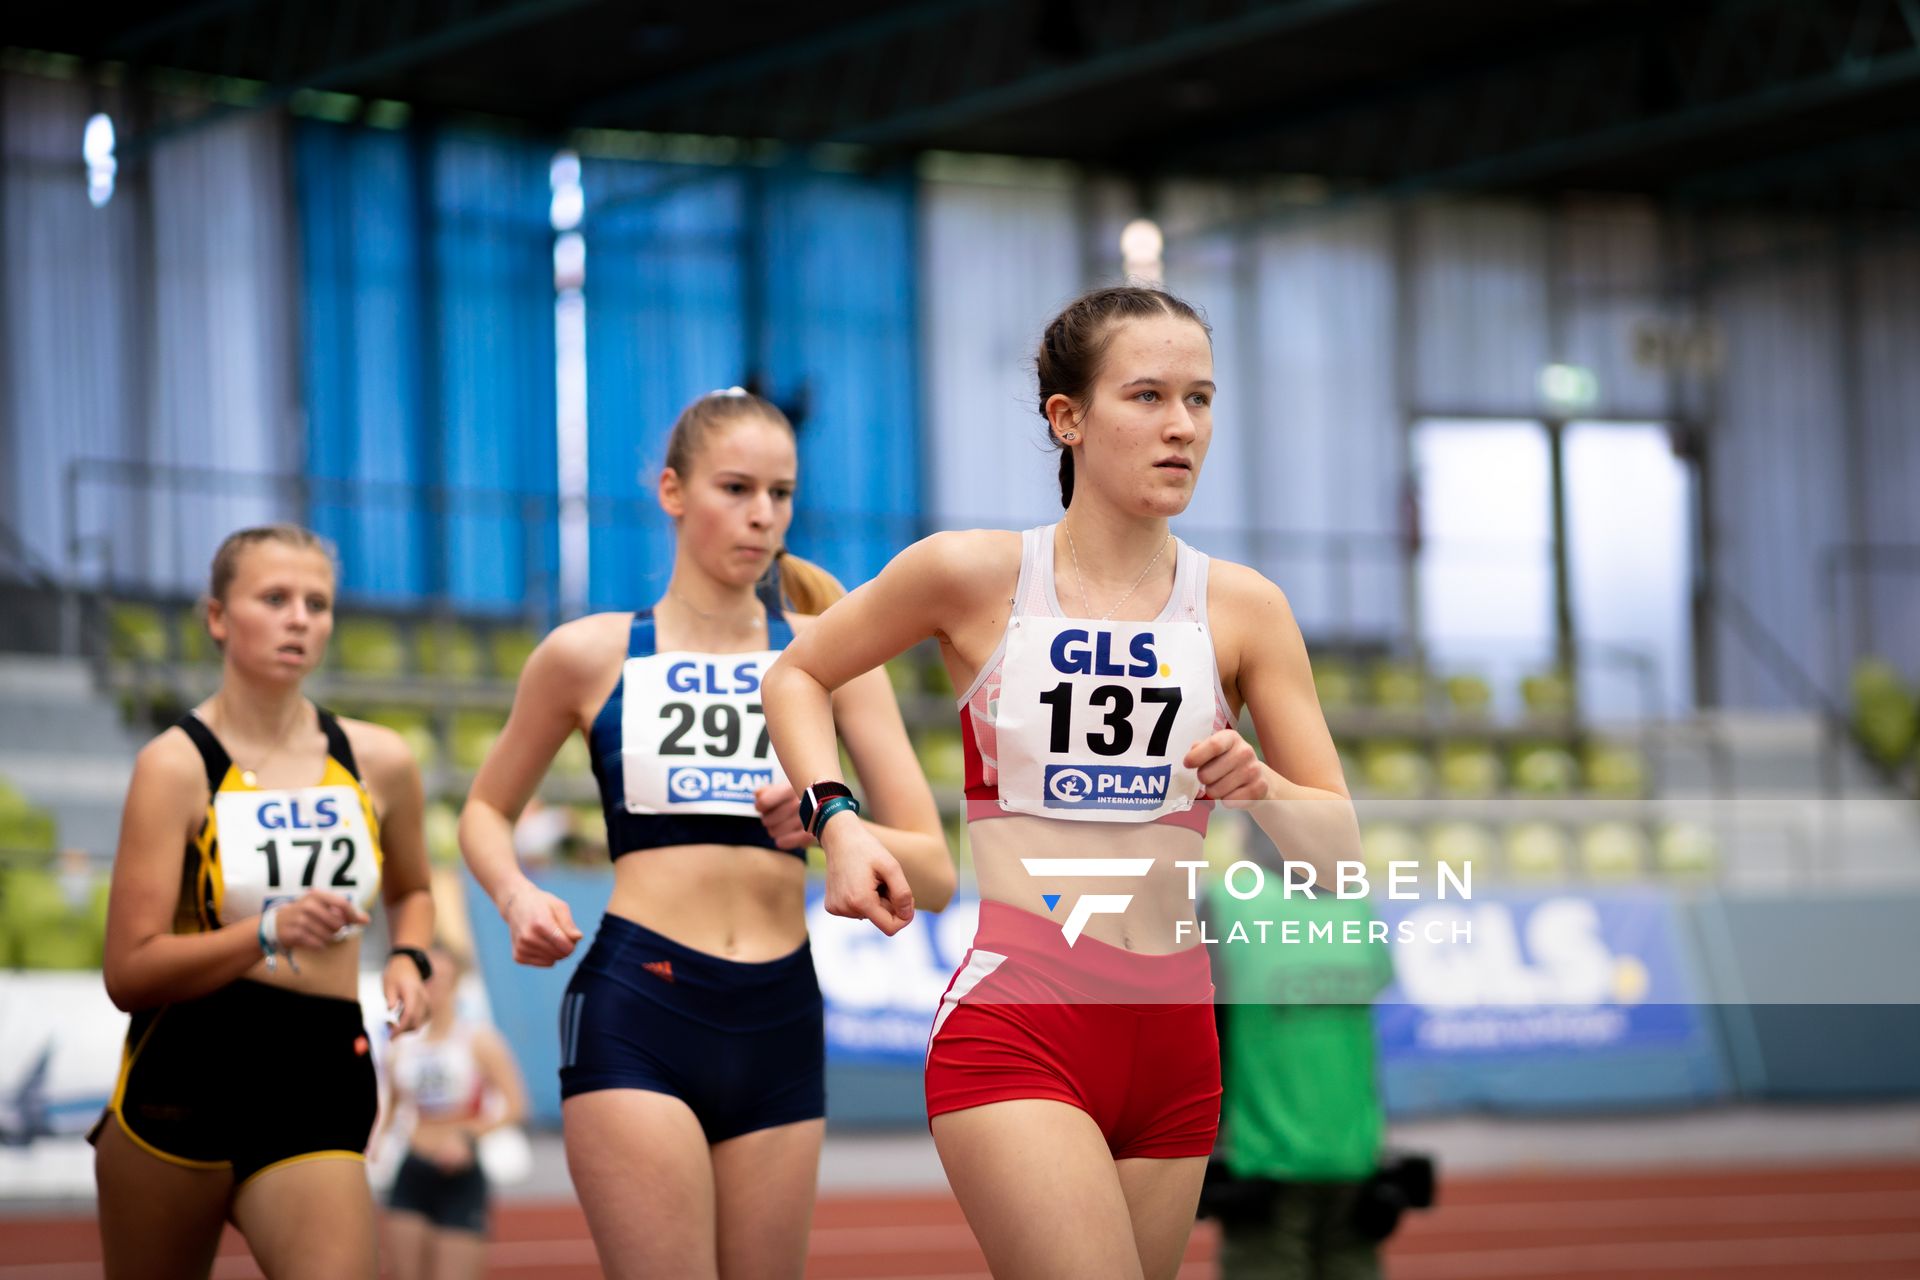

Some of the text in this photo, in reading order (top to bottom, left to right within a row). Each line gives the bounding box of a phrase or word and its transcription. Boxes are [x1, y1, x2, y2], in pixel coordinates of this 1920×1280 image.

[658, 702, 771, 759] 297
[1040, 682, 1182, 757] 137
[711, 771, 770, 791] PLAN
[1098, 774, 1165, 794] PLAN
[256, 838, 357, 887] 172
